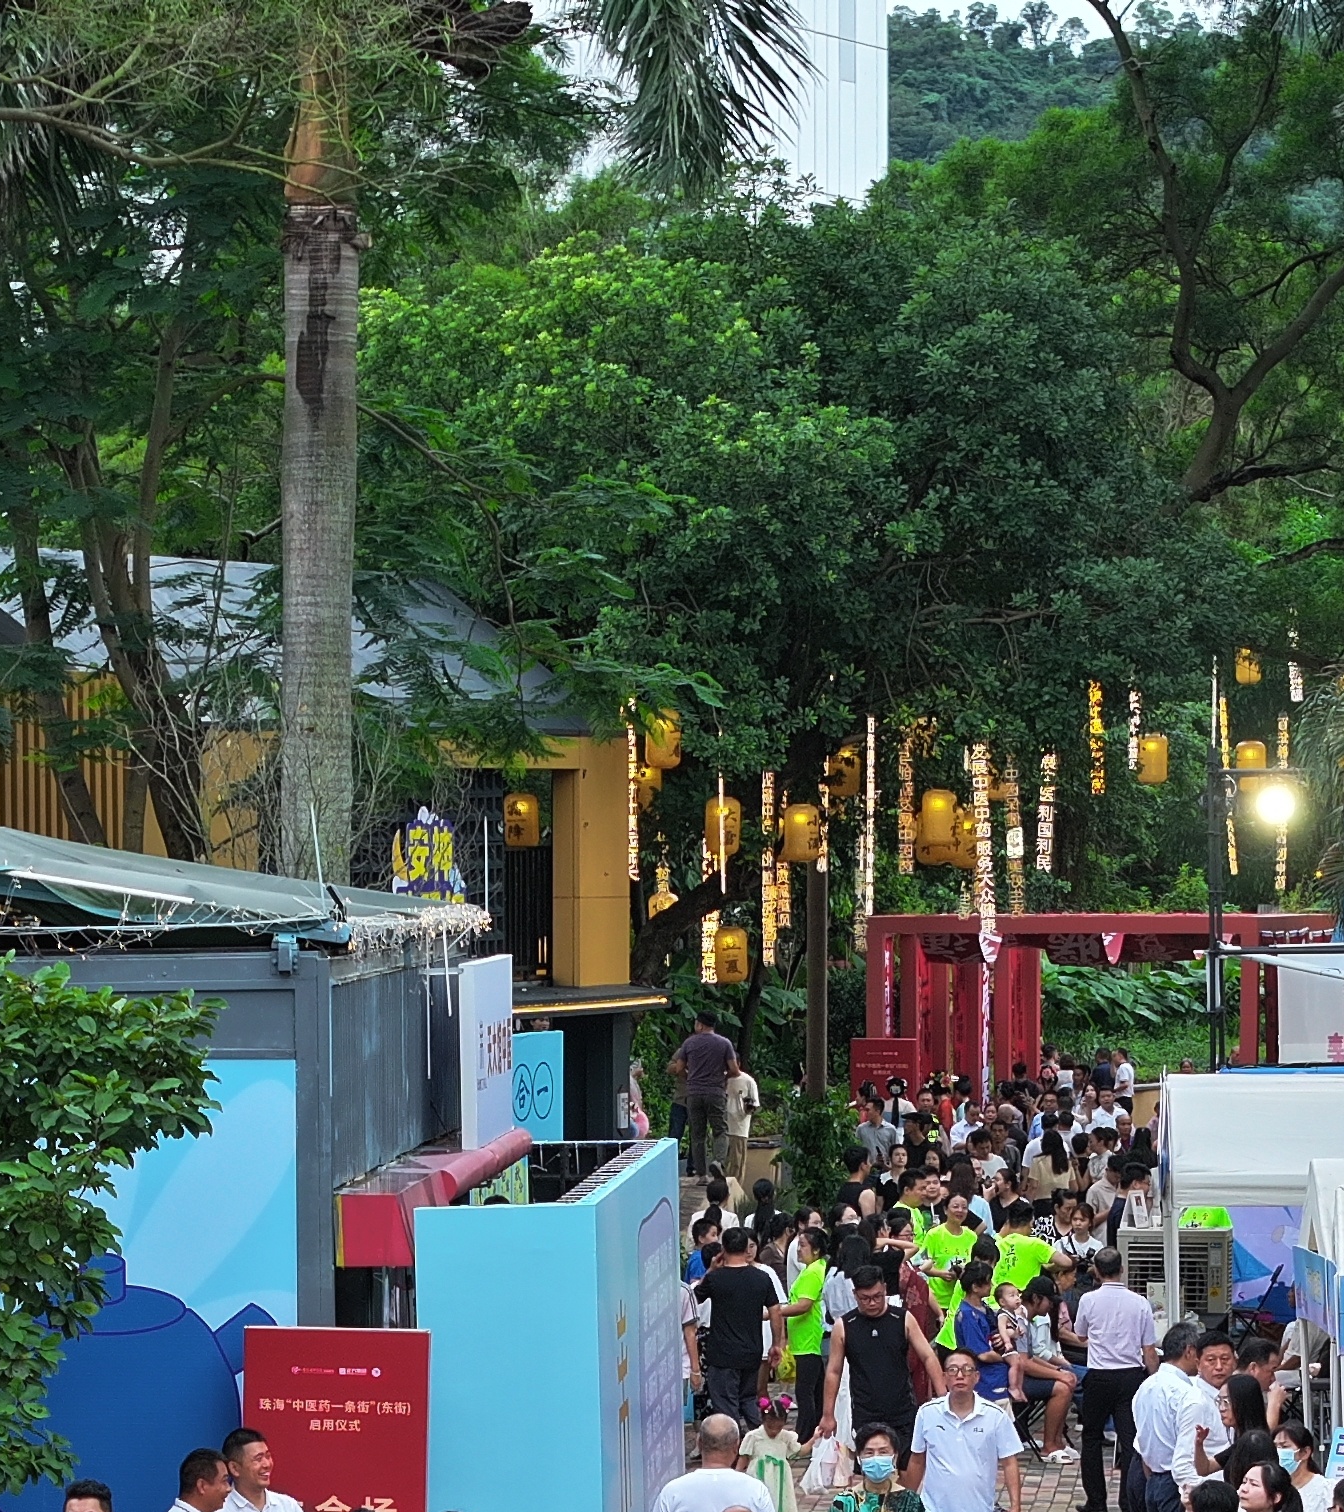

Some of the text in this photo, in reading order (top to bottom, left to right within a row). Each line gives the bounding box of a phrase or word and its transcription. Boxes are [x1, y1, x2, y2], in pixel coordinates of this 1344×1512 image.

[970, 743, 999, 937] 发展中医中药服务大众健康
[1035, 744, 1057, 874] 展医利国利民
[309, 1418, 362, 1433] 启用仪式
